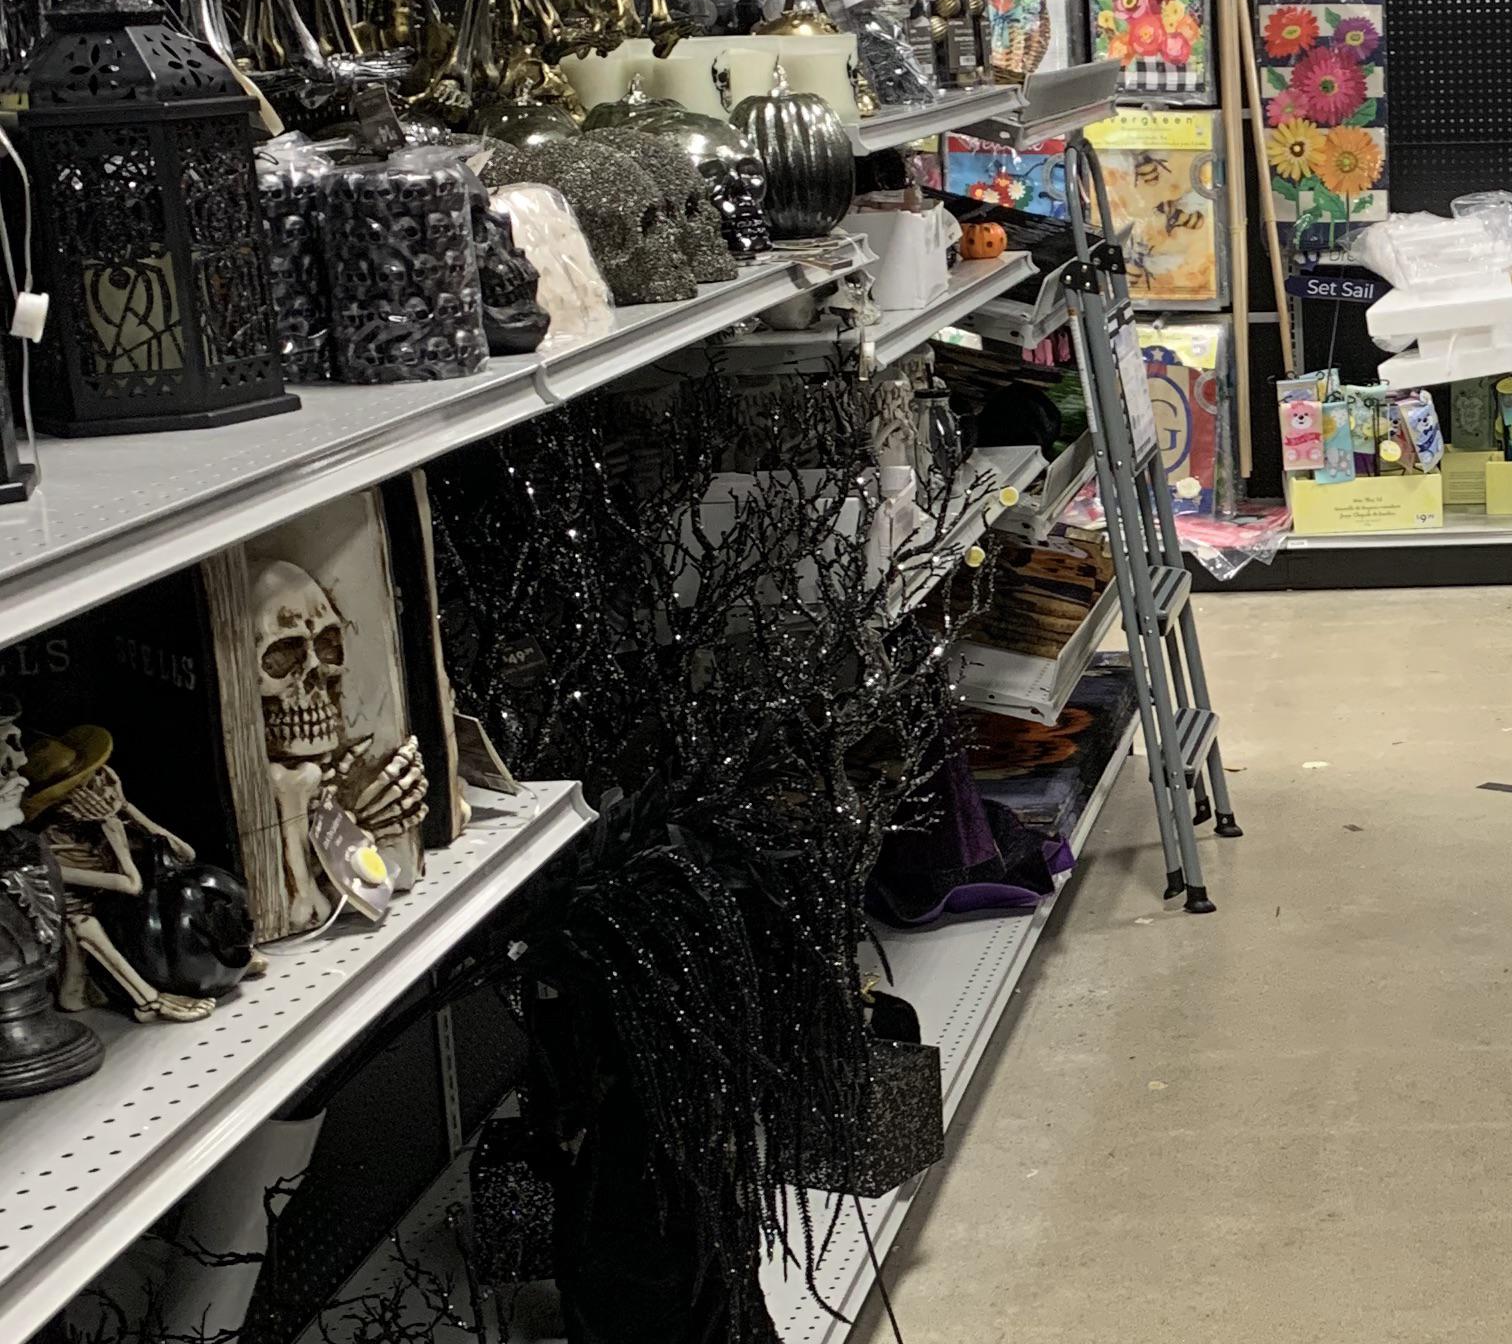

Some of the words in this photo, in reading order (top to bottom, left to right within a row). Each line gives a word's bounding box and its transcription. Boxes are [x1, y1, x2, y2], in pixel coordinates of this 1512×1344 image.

[1110, 117, 1192, 126] vergreen
[1307, 279, 1338, 296] Set
[1341, 281, 1375, 299] Sail
